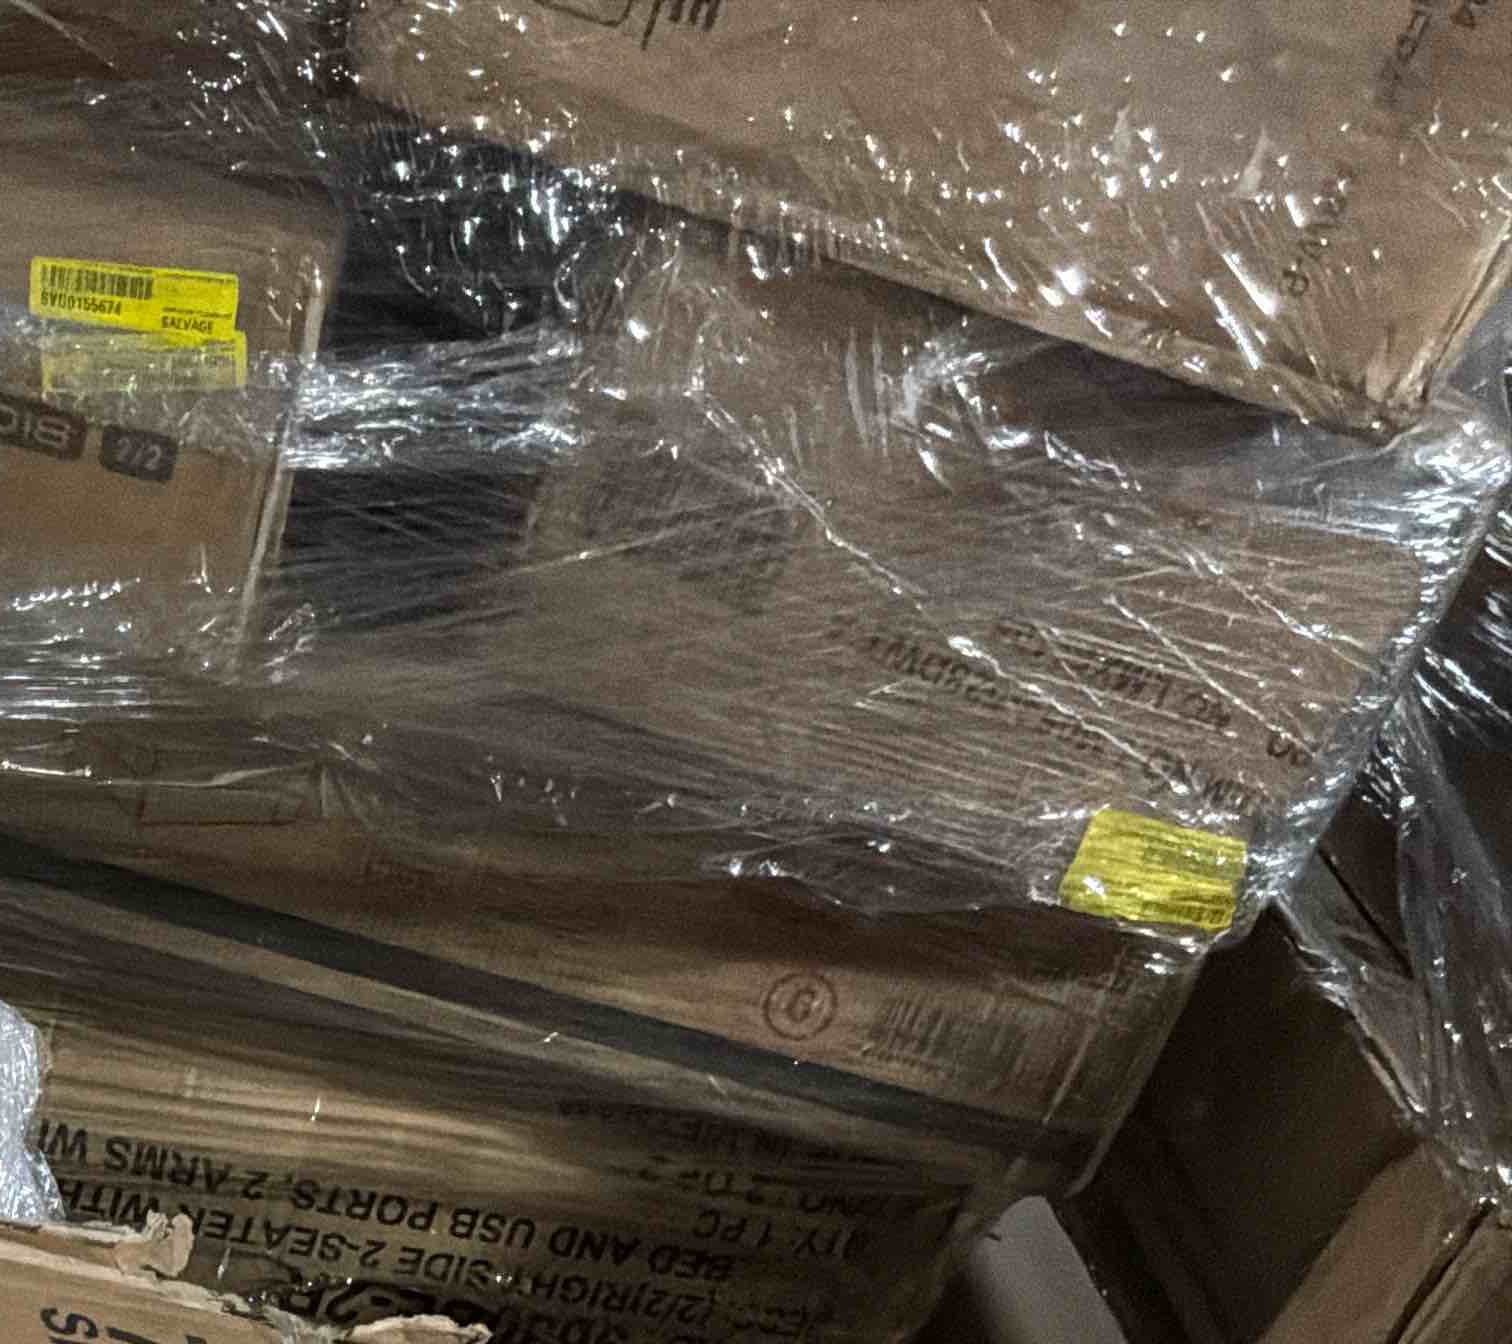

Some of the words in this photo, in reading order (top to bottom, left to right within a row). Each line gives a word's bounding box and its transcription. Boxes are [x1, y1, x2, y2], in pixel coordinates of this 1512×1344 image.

[99, 1132, 233, 1195] ARMS
[446, 1204, 538, 1251] USB
[545, 1222, 641, 1269] AND
